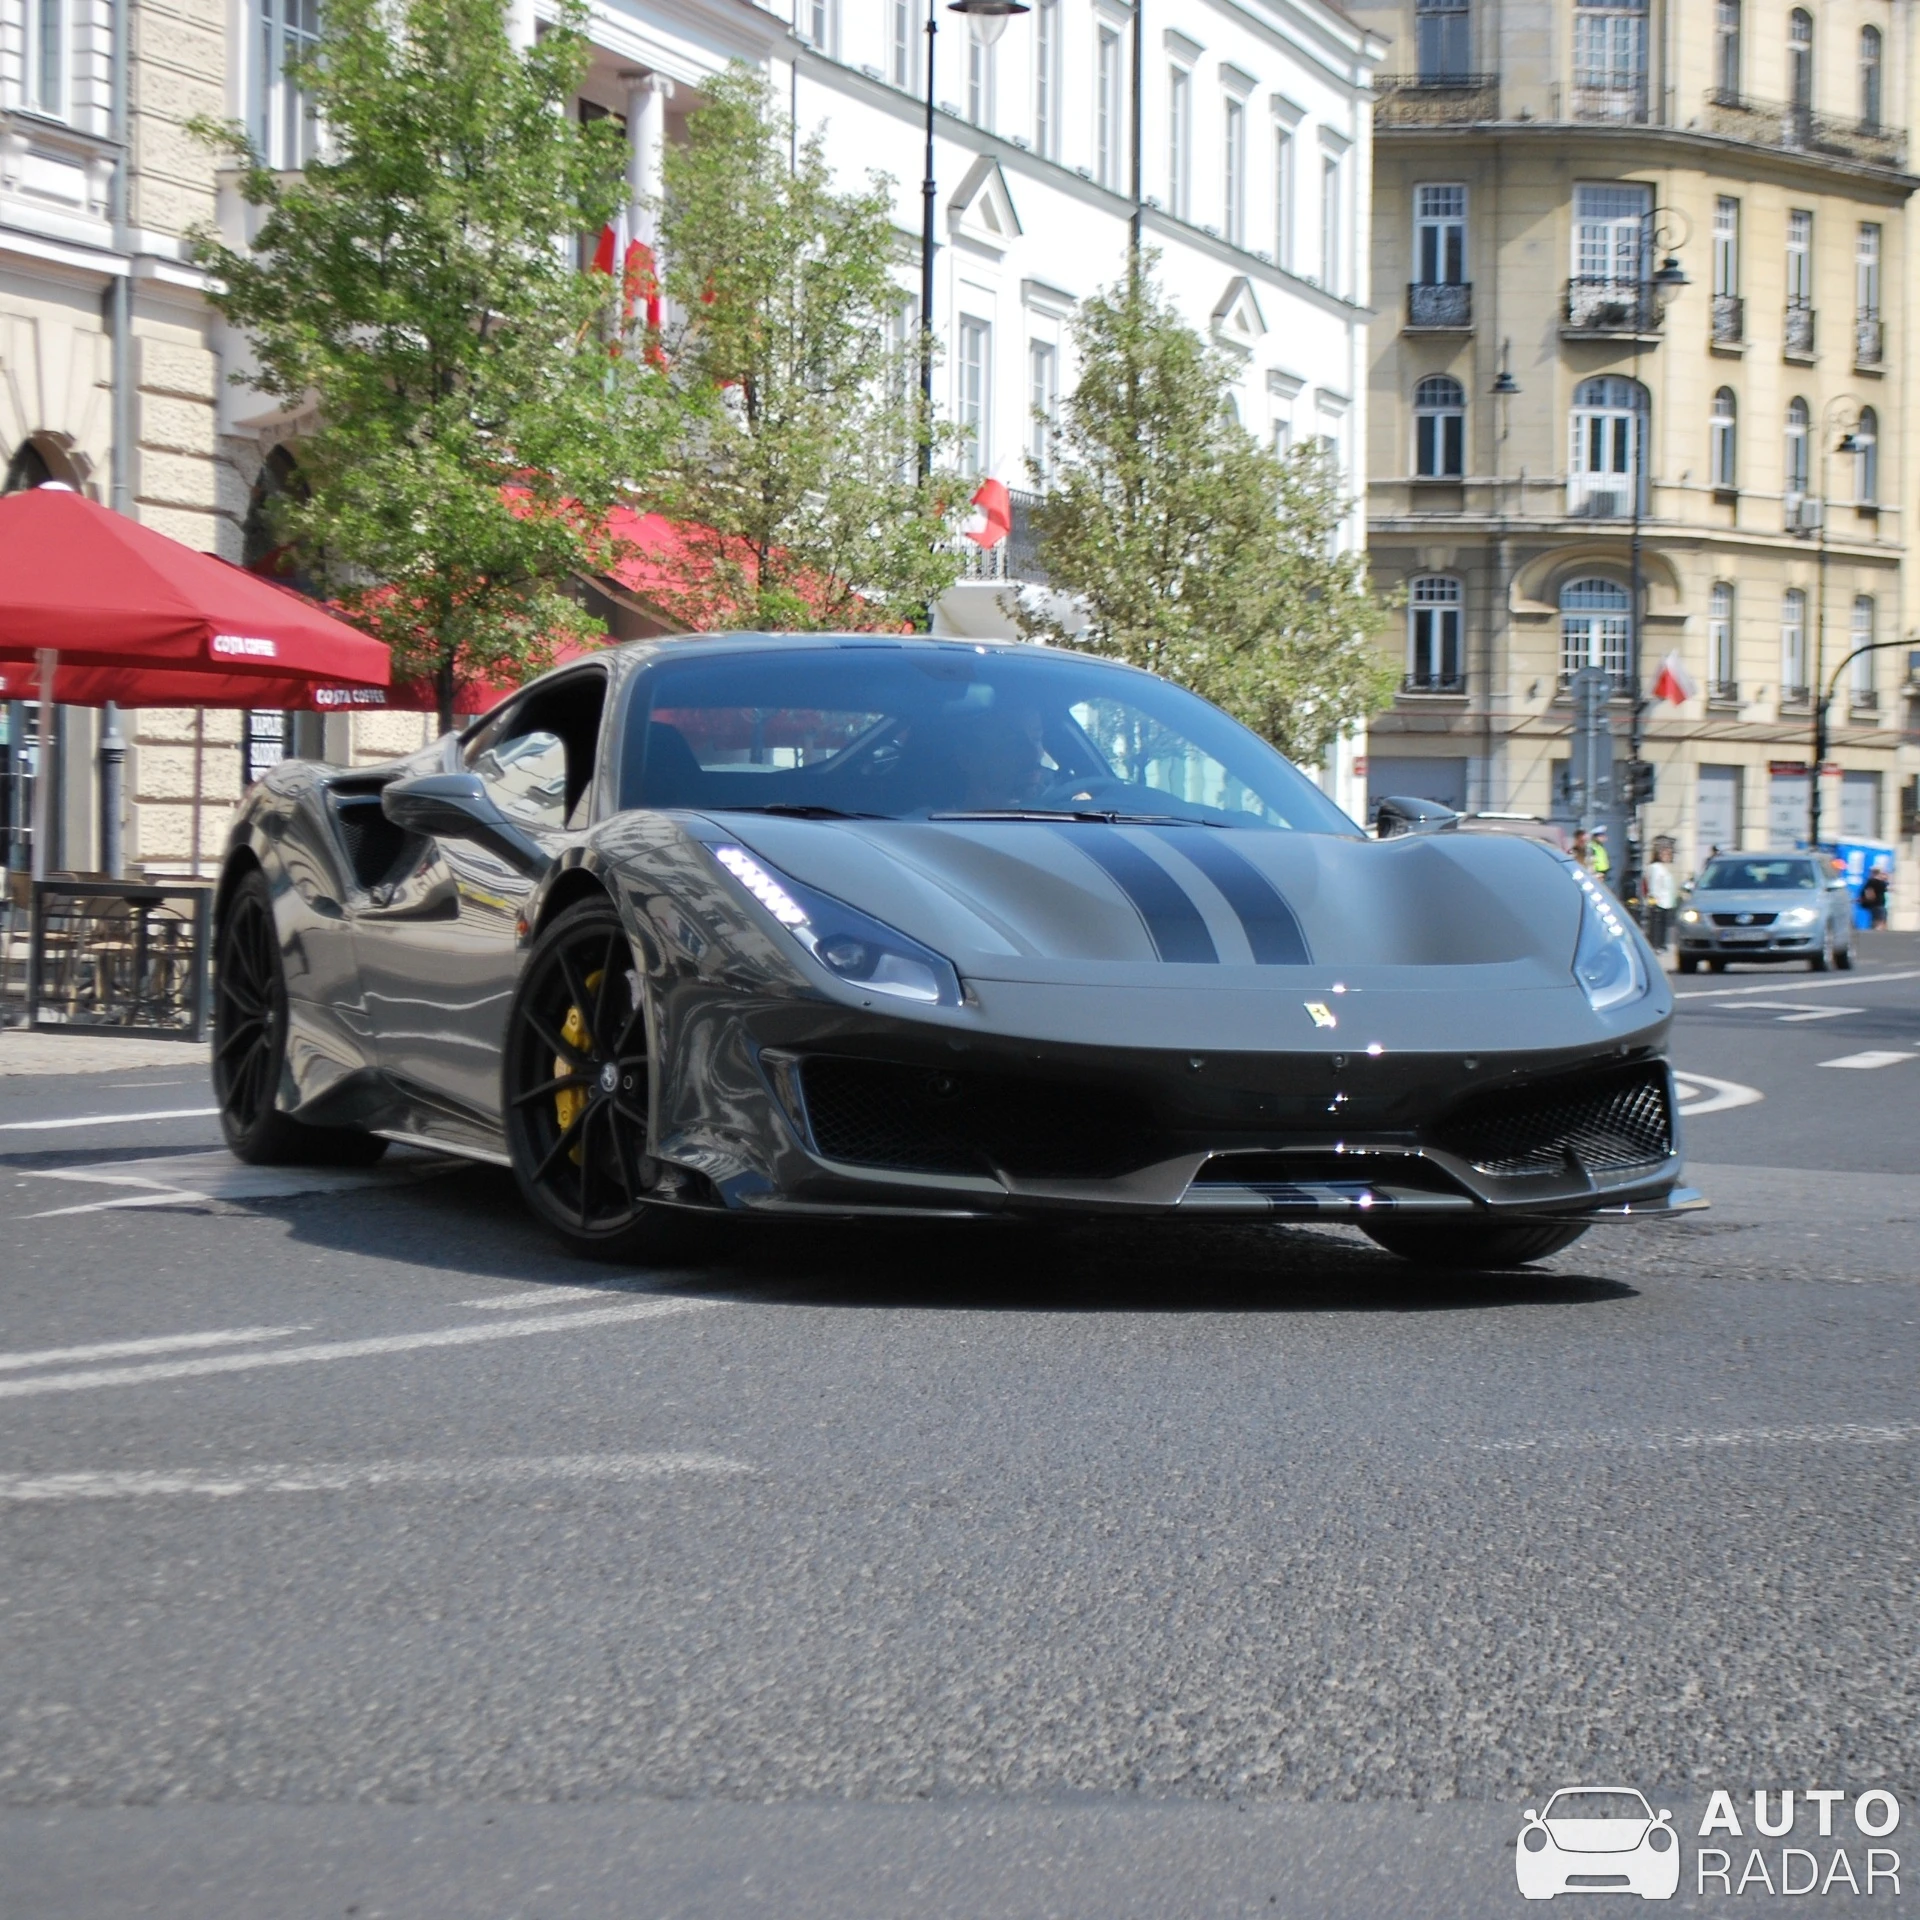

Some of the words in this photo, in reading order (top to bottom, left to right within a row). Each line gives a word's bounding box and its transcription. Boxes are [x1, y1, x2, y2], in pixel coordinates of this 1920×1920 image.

[213, 634, 245, 655] COSTA
[244, 637, 277, 657] COFFEE
[316, 688, 351, 705] COSTA
[352, 689, 386, 703] COFFEE
